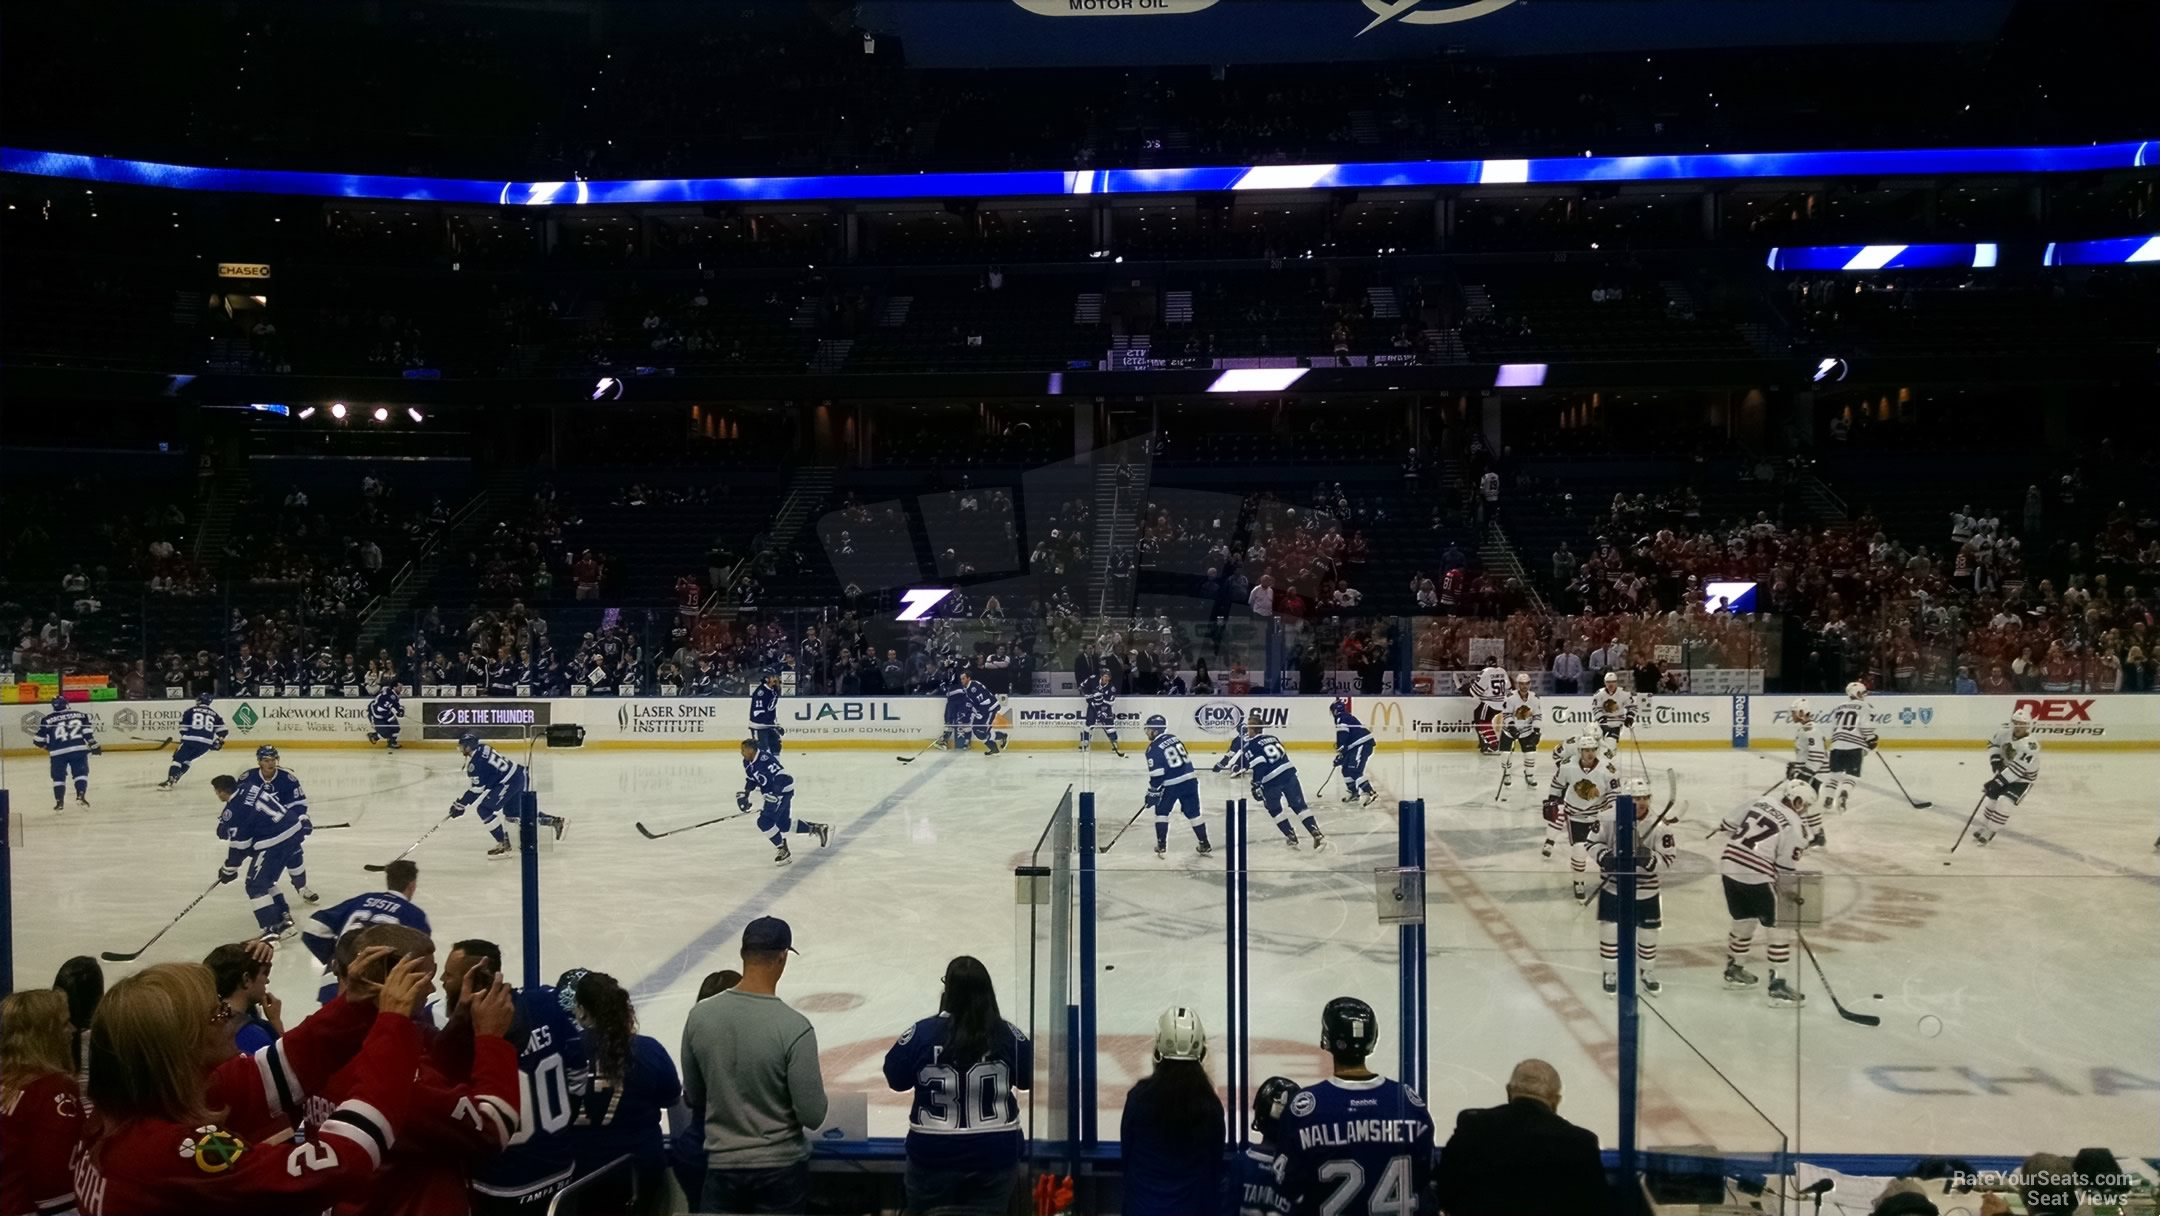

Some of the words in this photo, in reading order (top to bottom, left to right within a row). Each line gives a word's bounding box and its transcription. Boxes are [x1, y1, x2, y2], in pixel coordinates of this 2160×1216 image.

[1069, 0, 1133, 10] MOTOR
[1139, 0, 1168, 9] OIL
[219, 266, 259, 276] CHASE
[142, 710, 182, 719] FLORID
[262, 706, 330, 719] Lakewood
[334, 706, 369, 719] Ranc
[457, 710, 470, 724] BE
[472, 710, 489, 723] THE
[491, 709, 534, 723] THUNDER
[633, 704, 674, 718] LASER
[678, 704, 716, 719] SPINE
[794, 702, 901, 721] JABIL
[1020, 710, 1140, 720] MicroLen
[1204, 708, 1233, 719] FOX
[1552, 705, 1593, 724] Tam
[1656, 705, 1710, 724] Times
[1735, 696, 1746, 737] Reebok
[2013, 699, 2096, 721] DEX
[55, 719, 83, 741] 42
[142, 720, 176, 731] HOSPI
[192, 712, 215, 732] 86
[633, 720, 704, 733] INSTITUTE
[2031, 722, 2104, 736] imaging
[1164, 742, 1190, 768] 89
[1731, 810, 1780, 850] 57
[917, 1059, 1010, 1129] 30
[287, 1140, 338, 1177] 2
[1317, 1155, 1418, 1216] 24
